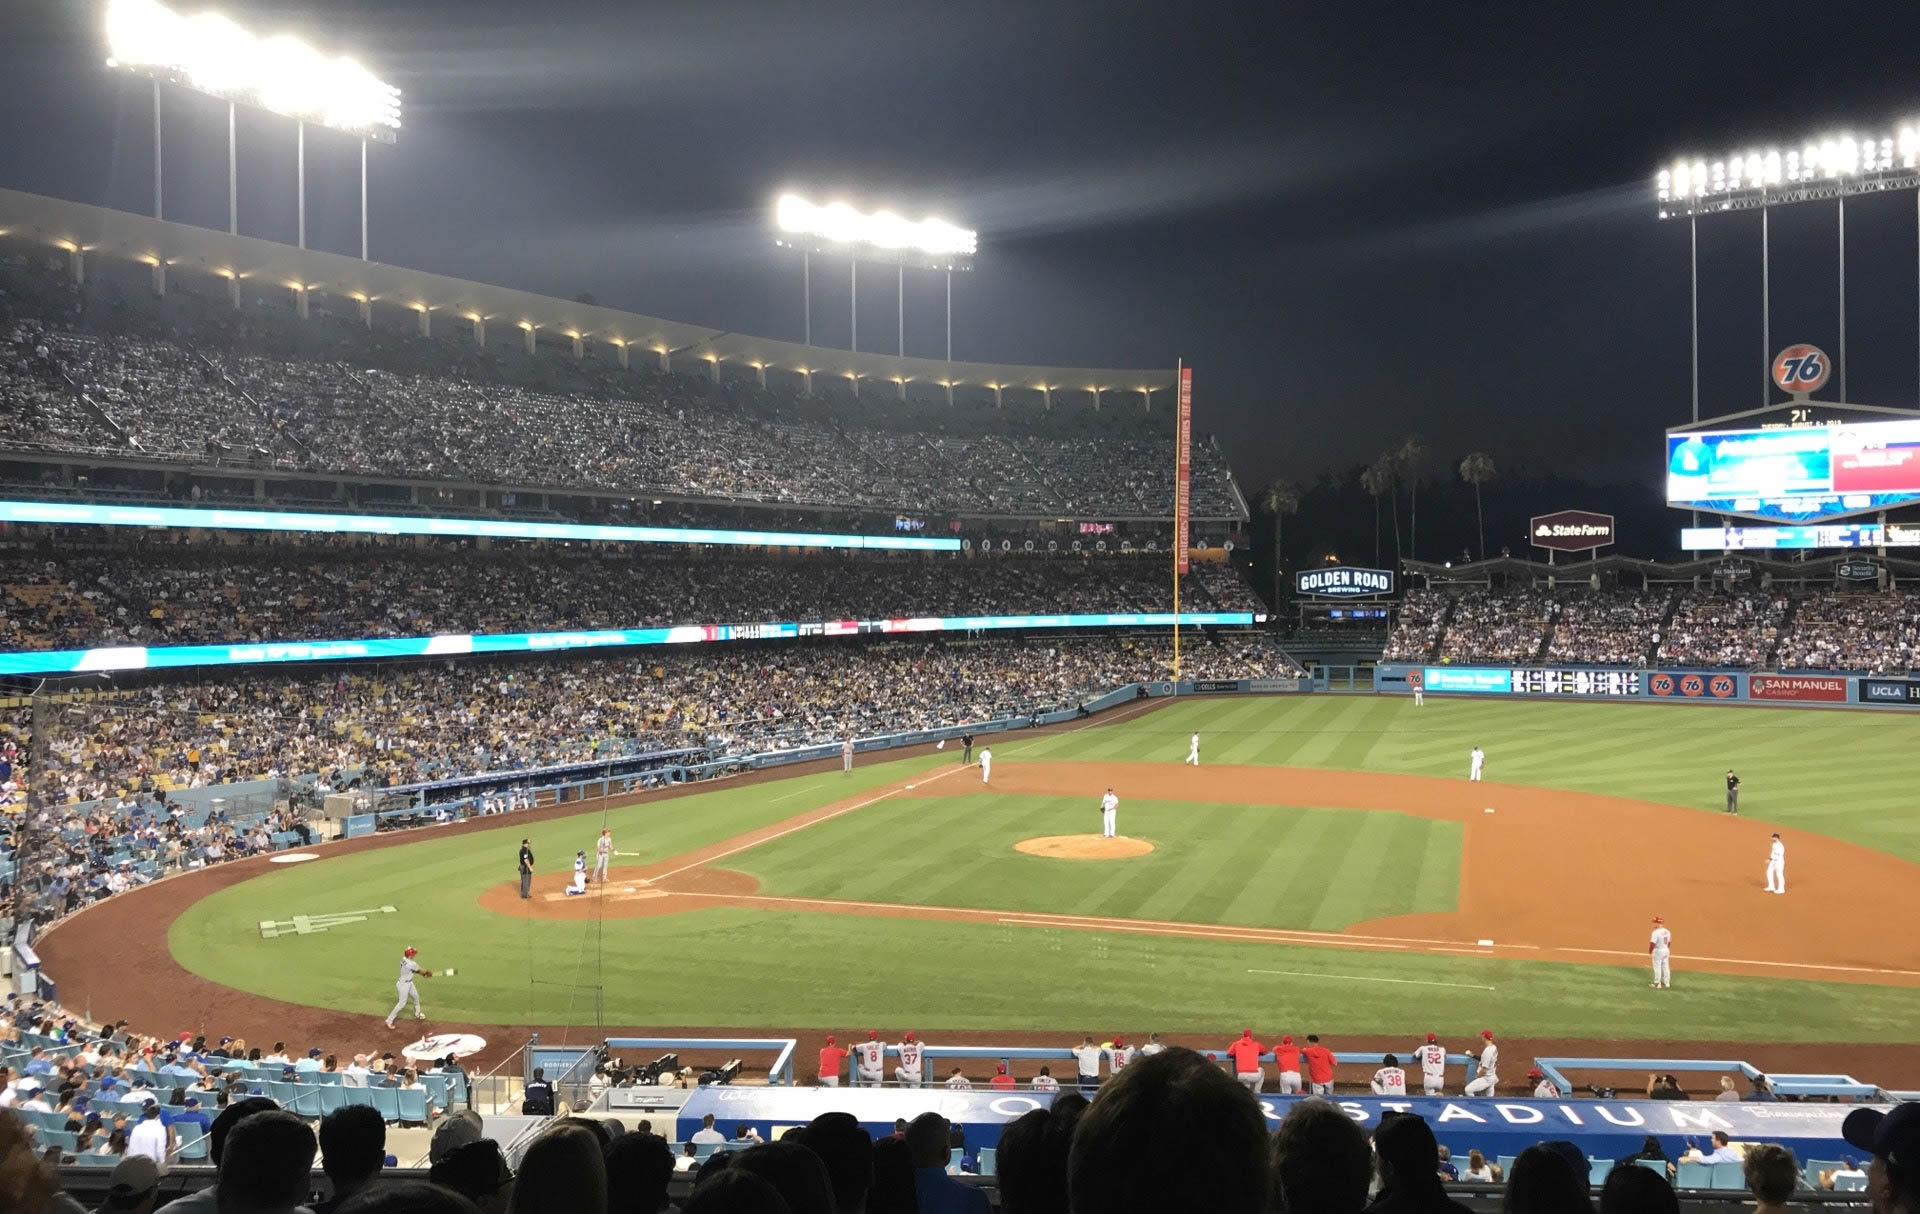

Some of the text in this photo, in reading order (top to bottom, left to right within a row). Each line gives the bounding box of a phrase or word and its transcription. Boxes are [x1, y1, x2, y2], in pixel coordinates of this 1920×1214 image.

[1781, 352, 1821, 385] 76
[1179, 419, 1190, 465] Emirates
[1178, 520, 1189, 565] Emirates
[1301, 571, 1388, 590] GOLDEN ROAD
[1411, 675, 1421, 683] 76
[1655, 679, 1730, 691] 76 76 76
[1765, 680, 1842, 691] SAN MANUEL
[1872, 687, 1902, 697] UCLA
[870, 1051, 877, 1062] 8
[904, 1053, 918, 1065] 37
[1114, 1056, 1125, 1069] 16
[1427, 1053, 1441, 1065] 52
[1387, 1074, 1402, 1087] 38
